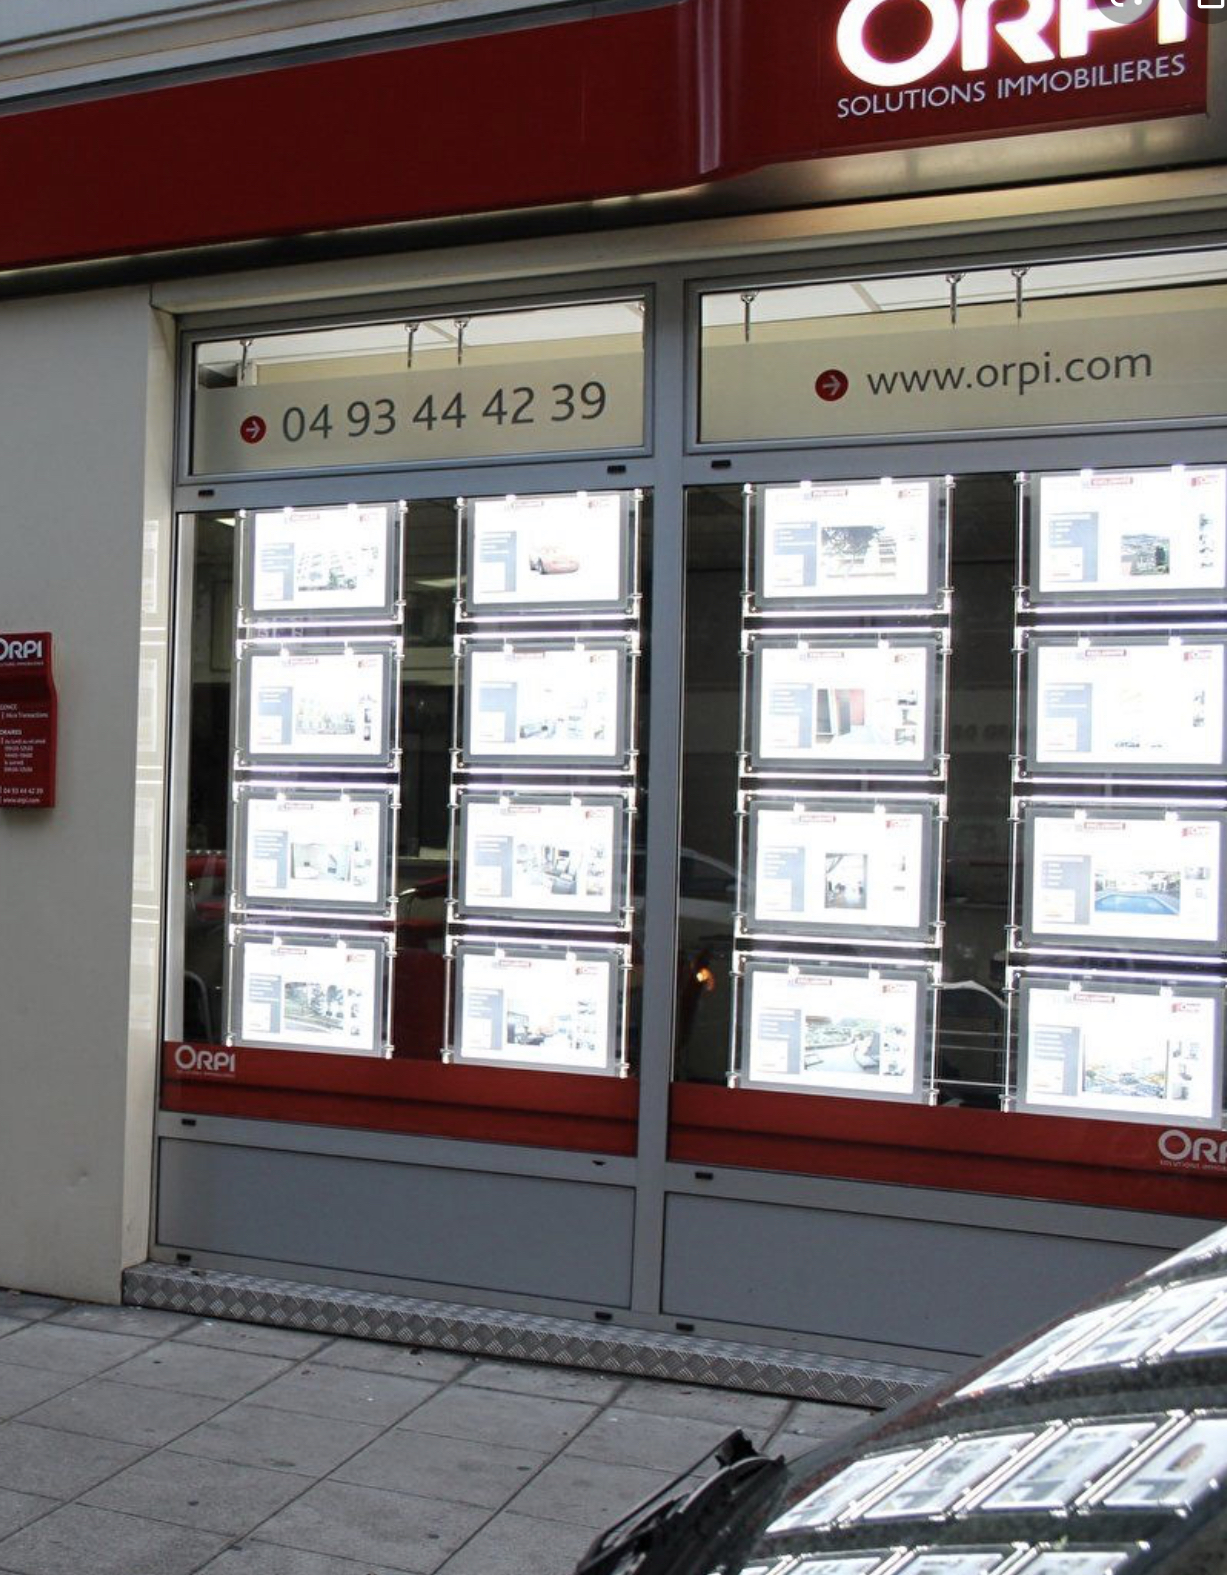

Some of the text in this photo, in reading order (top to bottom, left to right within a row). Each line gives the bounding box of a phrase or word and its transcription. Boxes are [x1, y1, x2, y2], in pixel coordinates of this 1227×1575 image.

[836, 0, 1188, 87] ORPI
[837, 54, 1186, 118] SOLUTIONS IMMOBILIERES
[867, 351, 1152, 396] www.orpi.com
[282, 380, 606, 442] 04 93 44 42 39
[175, 1045, 235, 1072] ORPI
